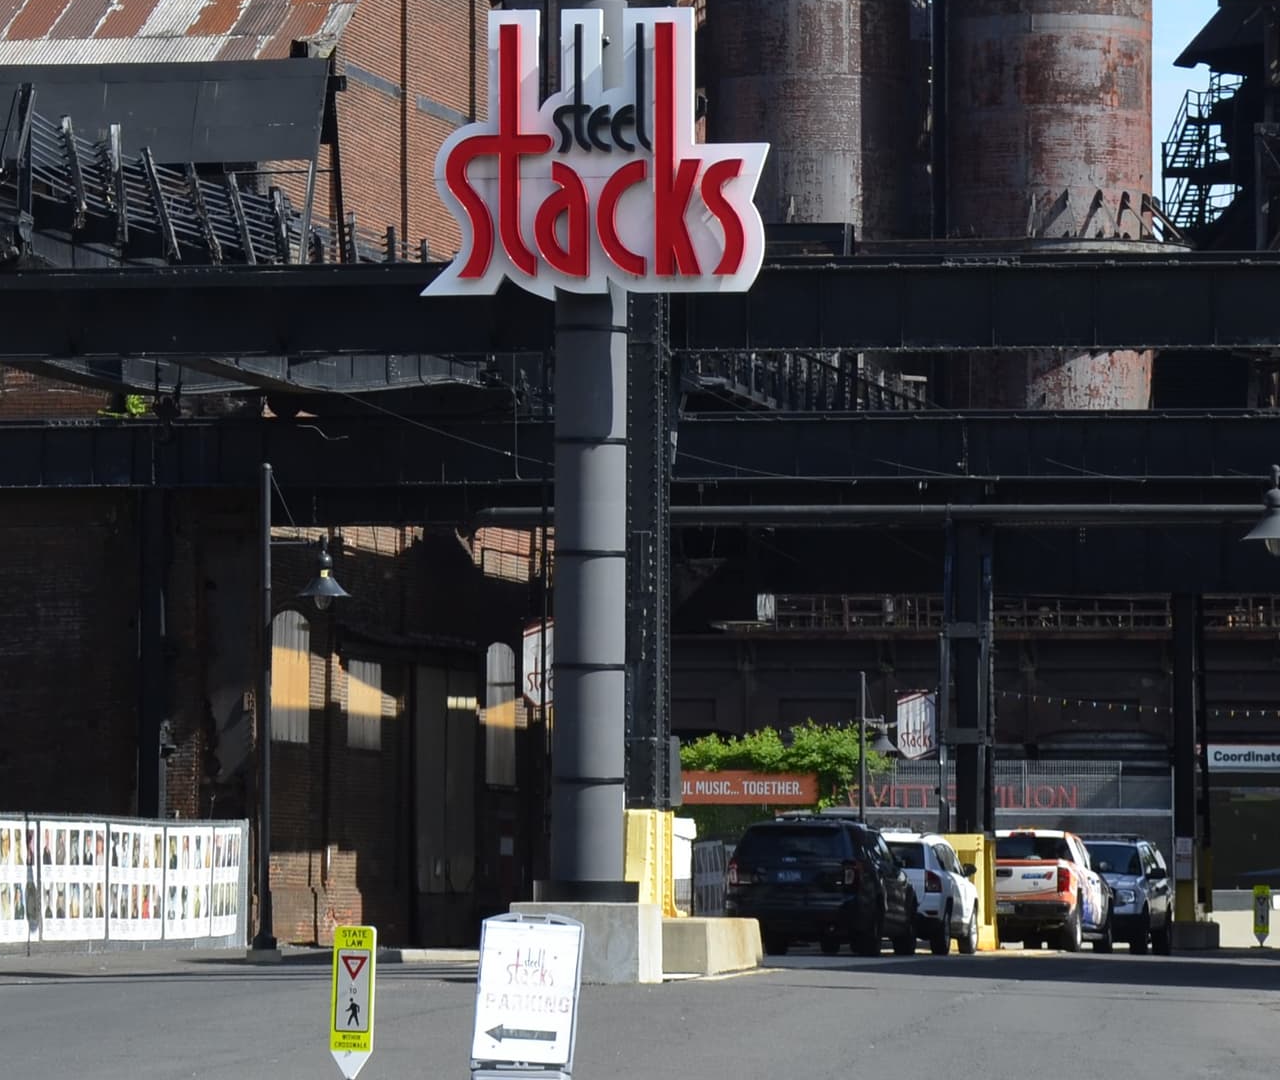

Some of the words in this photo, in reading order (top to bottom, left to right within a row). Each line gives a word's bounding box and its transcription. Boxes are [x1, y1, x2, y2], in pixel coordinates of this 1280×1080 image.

[552, 22, 651, 153] steel
[445, 21, 746, 278] stacks
[901, 719, 933, 749] stacks
[695, 780, 740, 796] MUSIC...
[742, 780, 804, 796] TOGETHER.
[341, 929, 368, 939] STATE
[345, 939, 364, 948] LAW
[506, 947, 554, 987] stacks
[524, 947, 542, 968] steel
[485, 992, 571, 1014] PARKING
